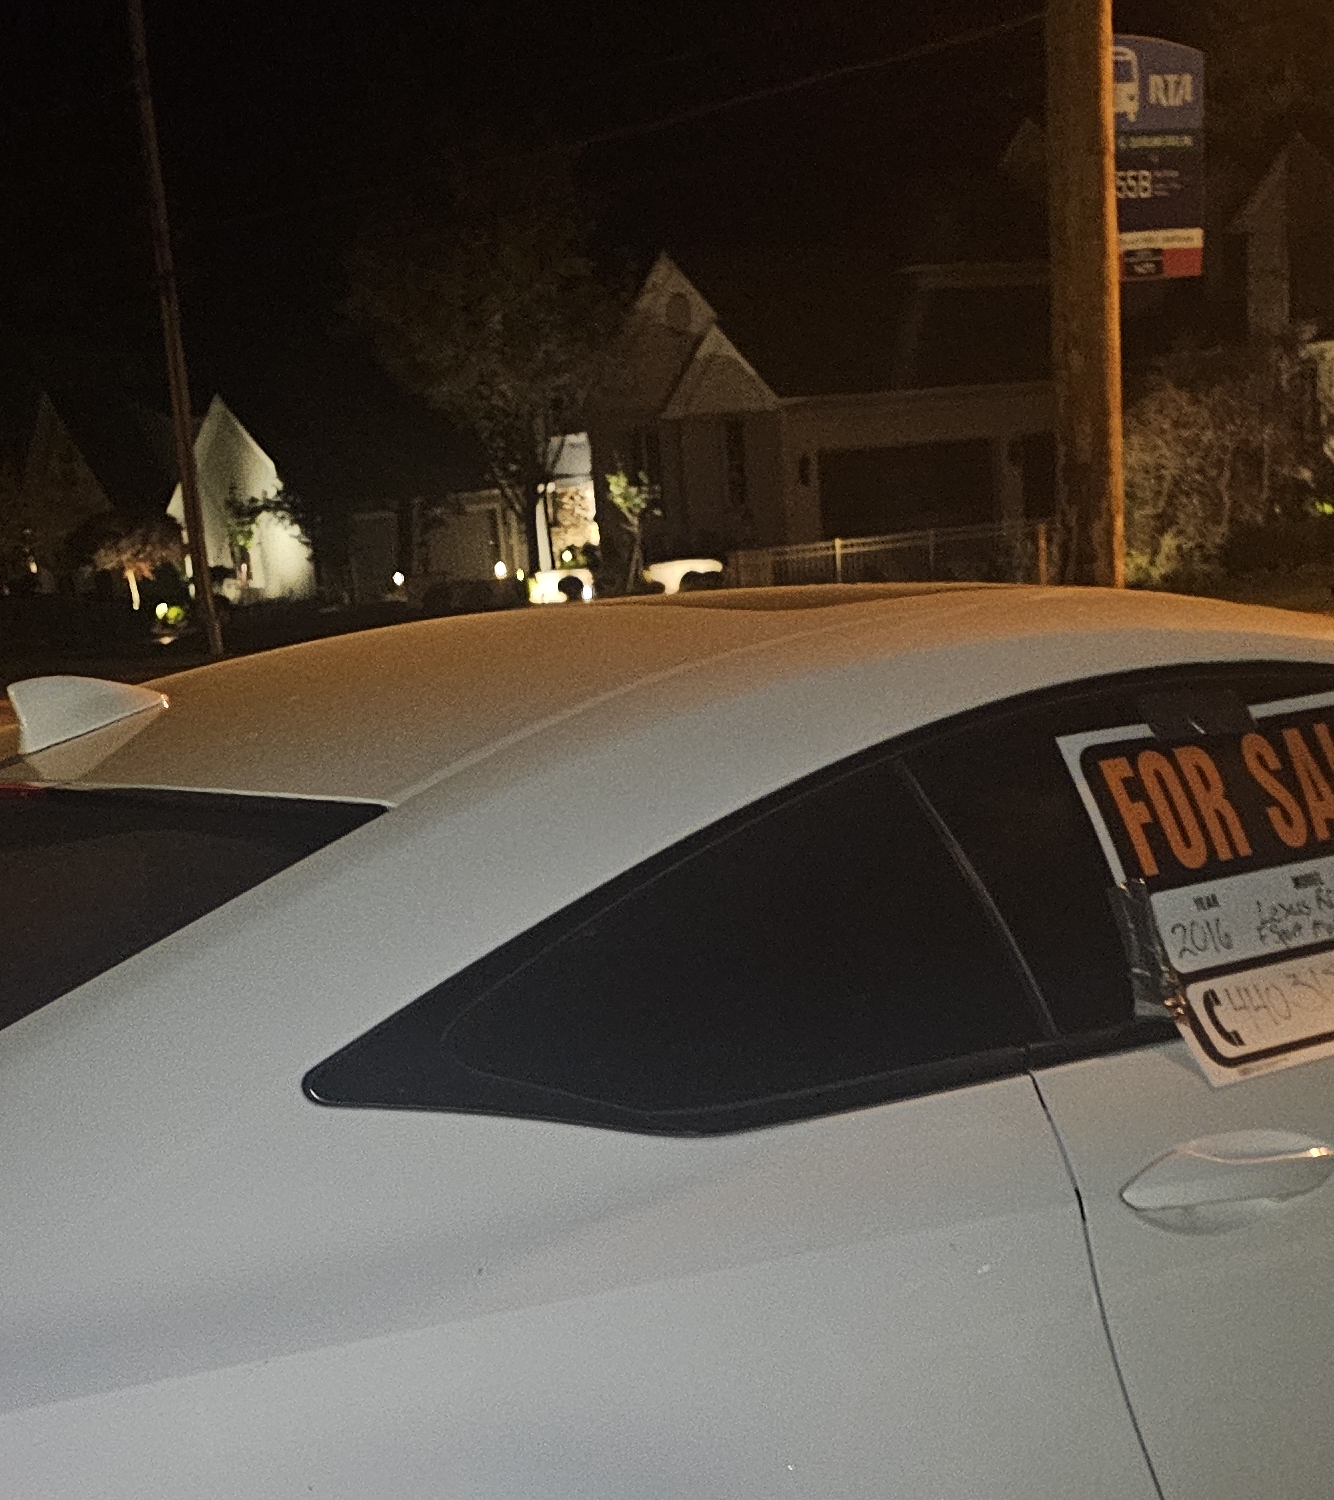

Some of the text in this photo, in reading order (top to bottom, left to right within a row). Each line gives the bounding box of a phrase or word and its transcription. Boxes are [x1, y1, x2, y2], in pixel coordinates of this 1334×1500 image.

[1149, 73, 1192, 106] RTA
[1099, 746, 1252, 877] FOR
[1171, 917, 1233, 958] 2016
[1223, 980, 1292, 1032] 440
